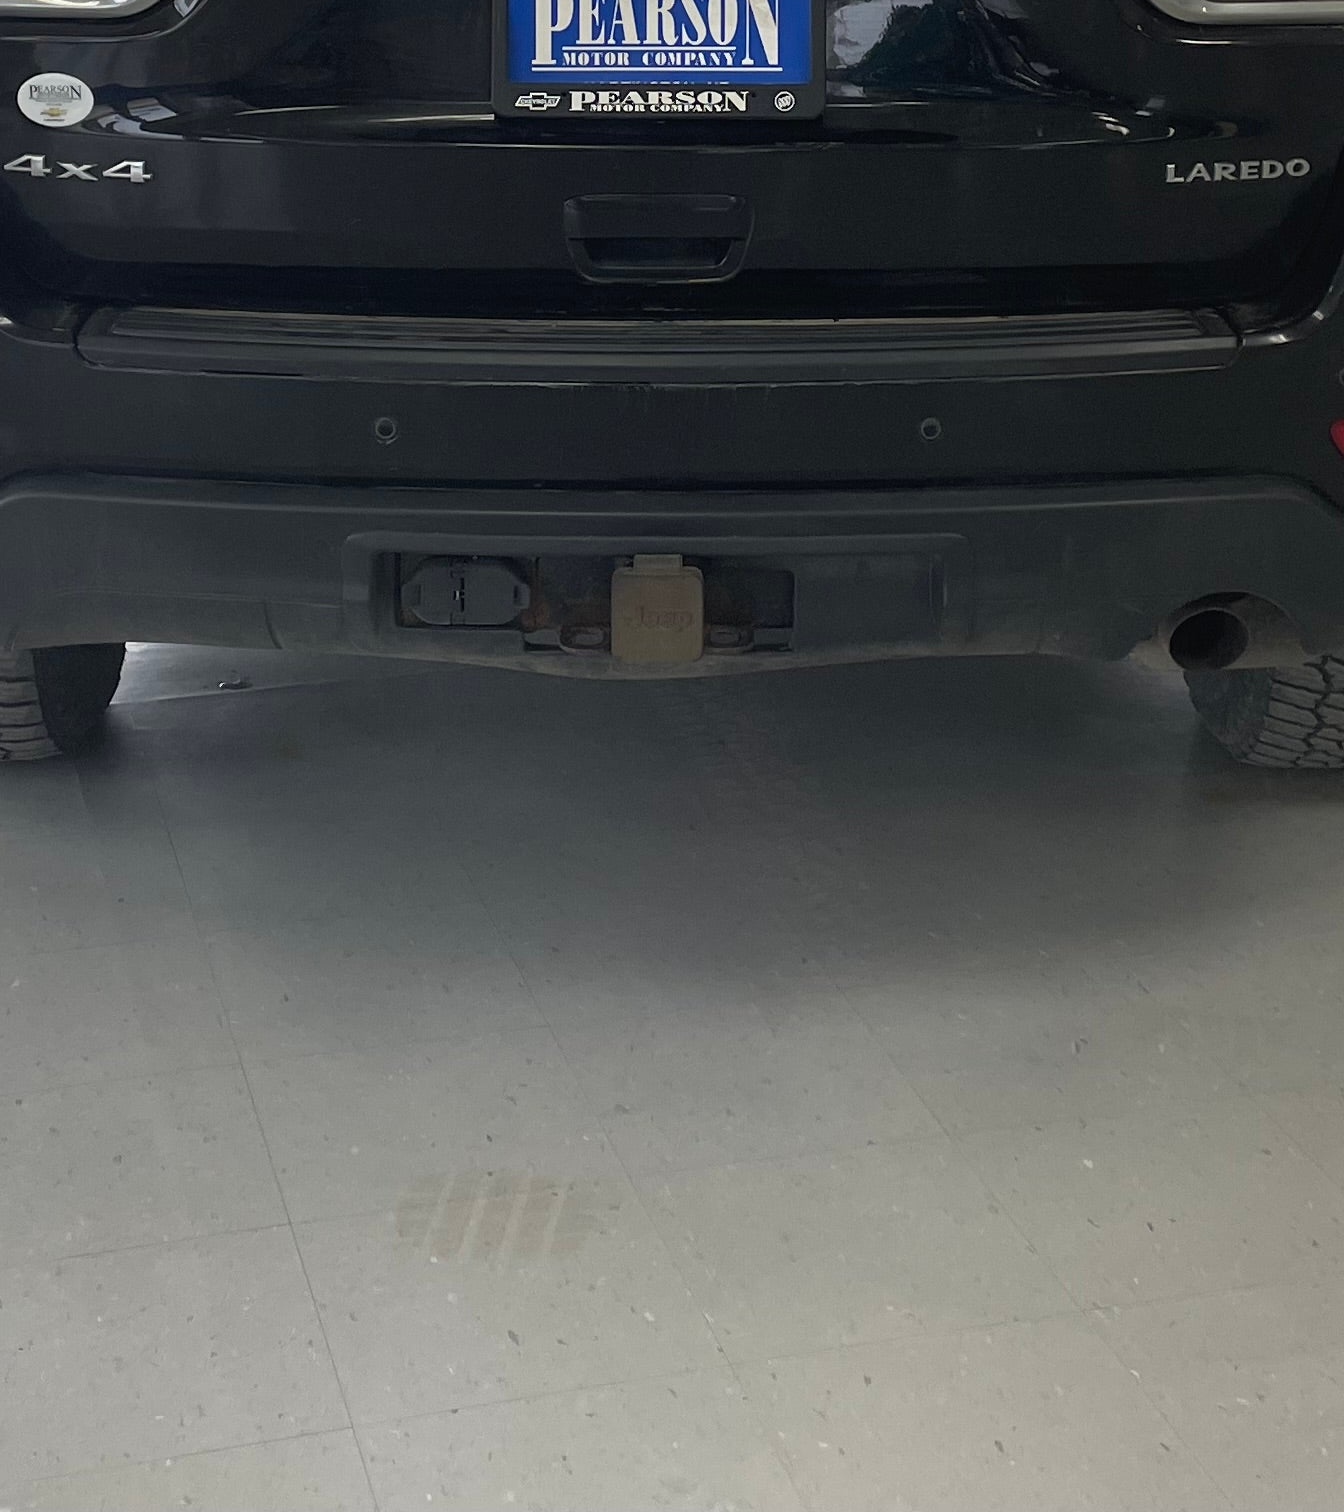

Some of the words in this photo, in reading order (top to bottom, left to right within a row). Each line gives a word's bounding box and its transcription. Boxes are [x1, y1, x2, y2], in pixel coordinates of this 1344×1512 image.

[562, 52, 630, 66] MOTOR
[642, 52, 737, 66] COMPANY
[29, 84, 82, 100] PEARSON
[569, 90, 749, 112] PEARSON
[589, 103, 648, 113] MOTOR
[650, 103, 724, 113] COMPANY
[3, 154, 153, 183] 4x4
[1165, 157, 1311, 183] LAREDO
